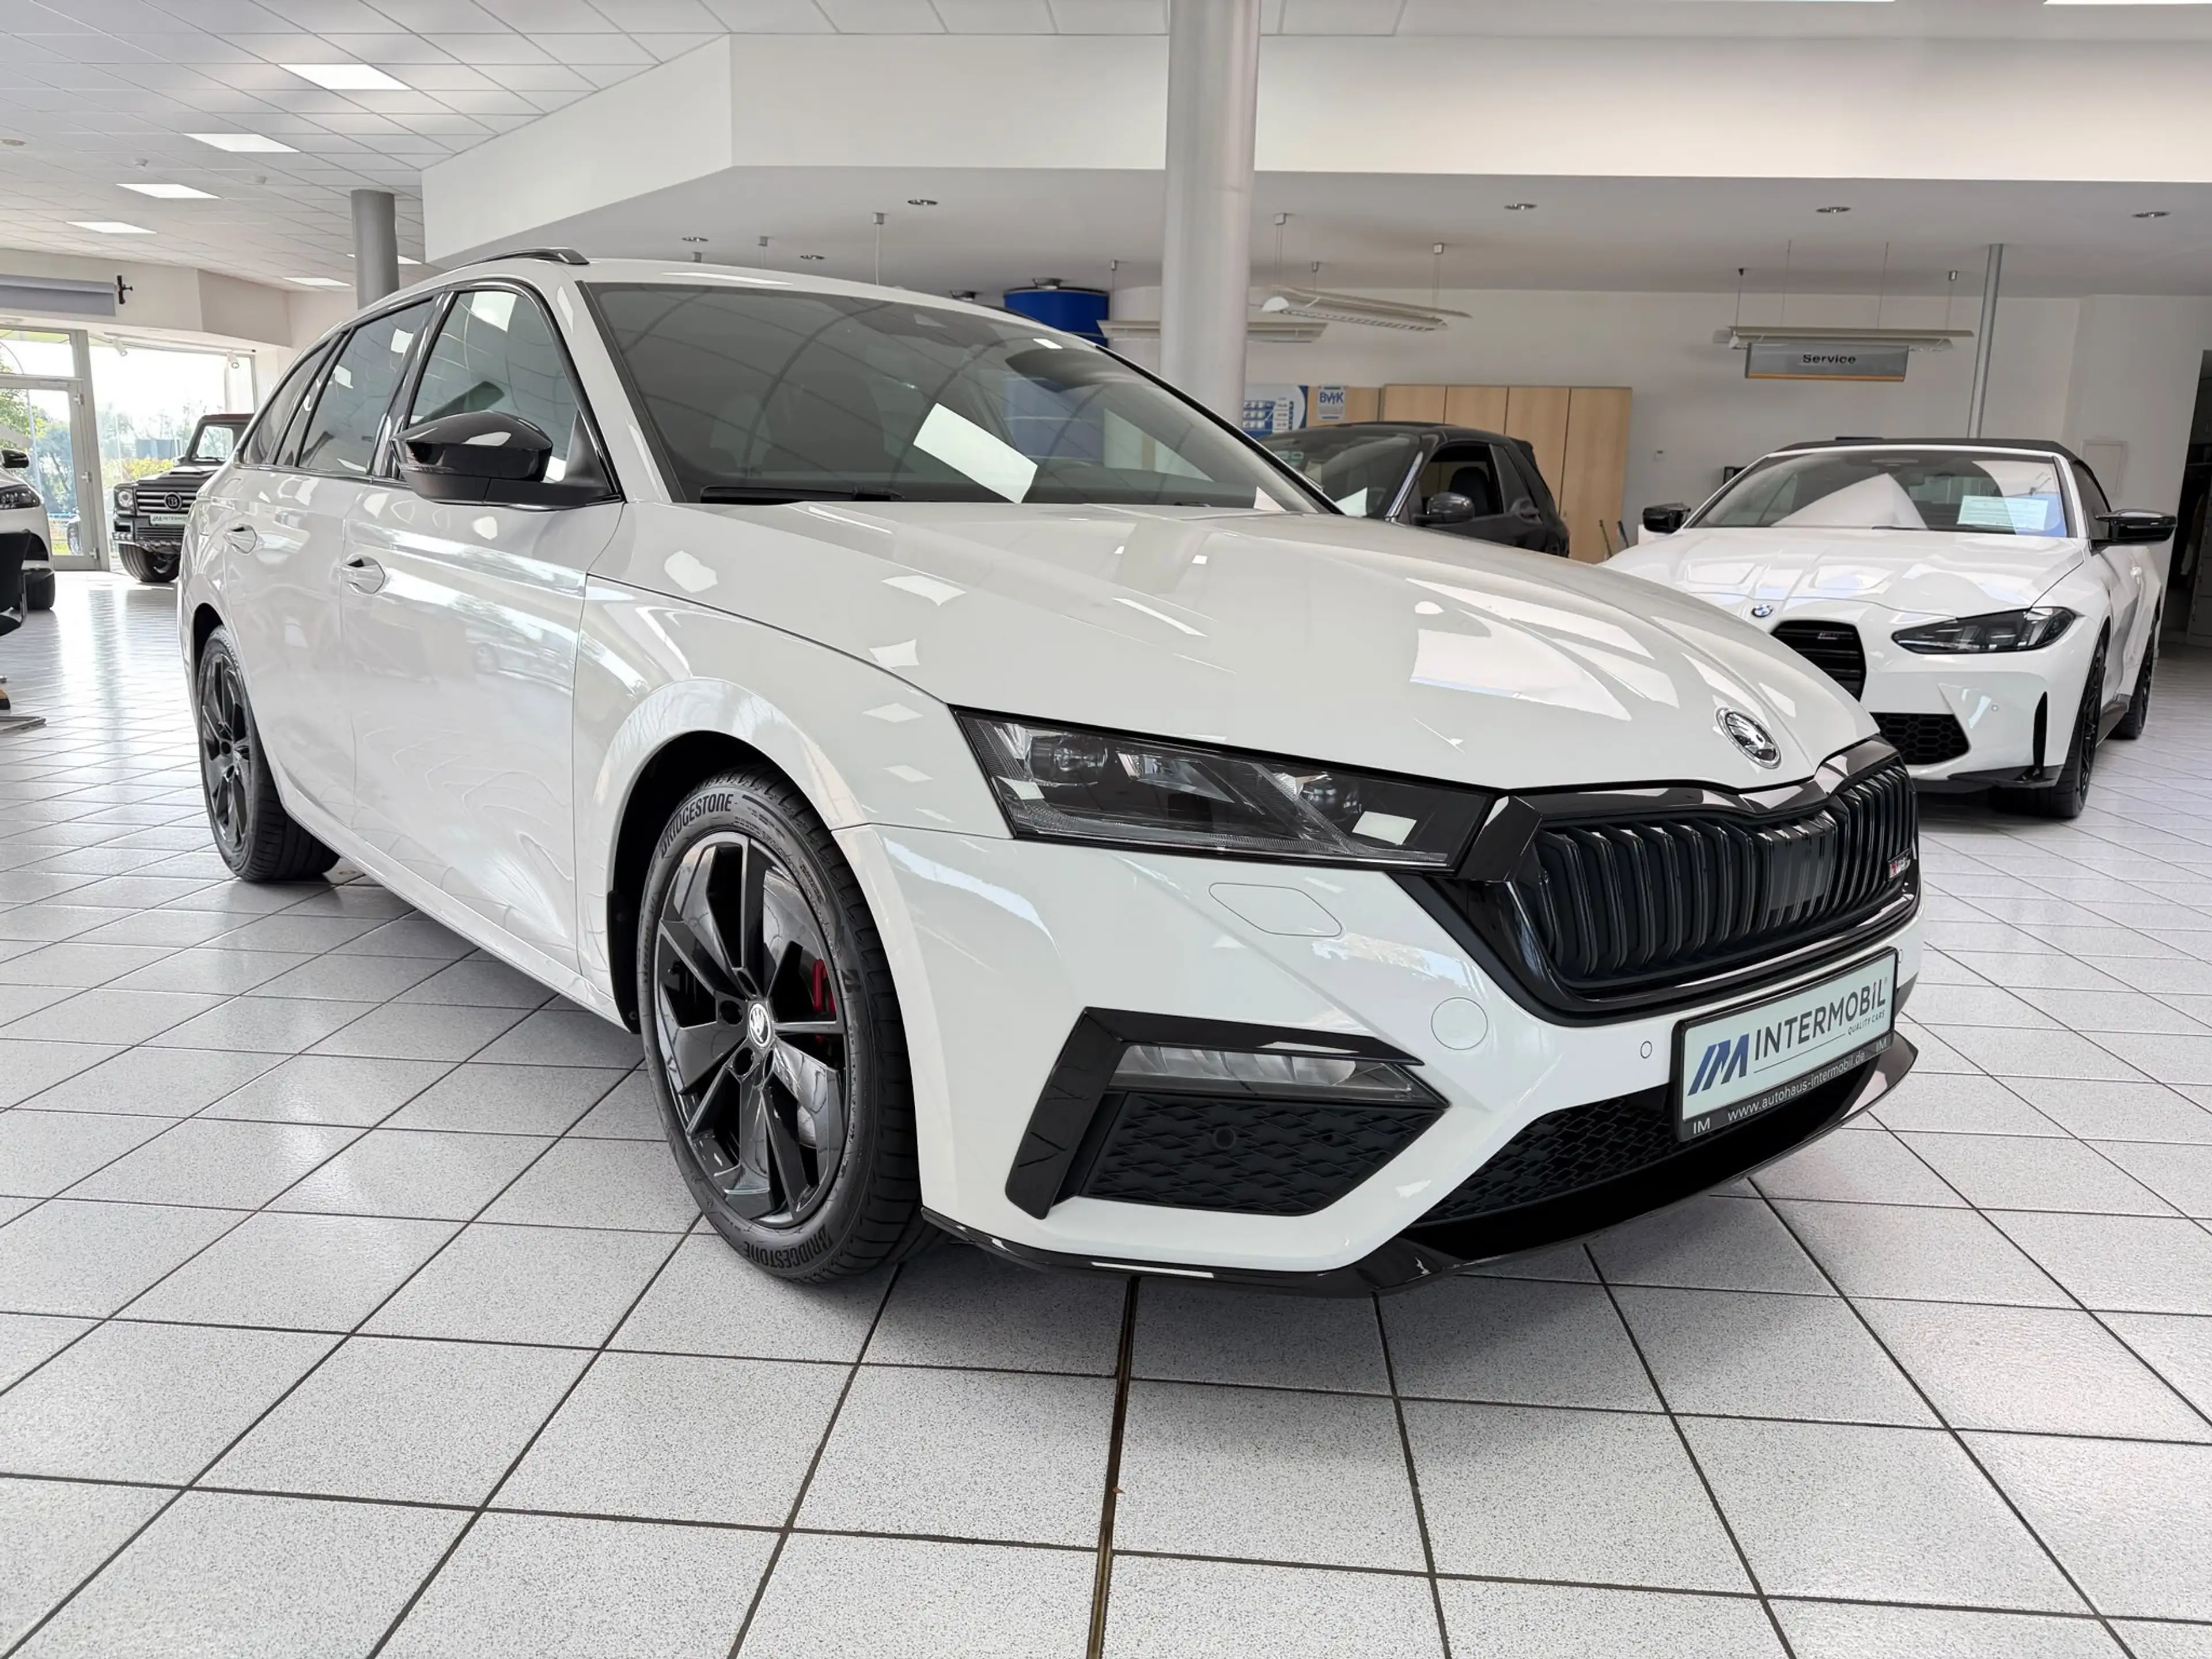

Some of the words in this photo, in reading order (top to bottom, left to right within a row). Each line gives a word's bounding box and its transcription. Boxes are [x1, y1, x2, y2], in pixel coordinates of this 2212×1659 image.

[1802, 354, 1856, 364] Service
[661, 793, 734, 857] BRIDGESTONE
[1848, 1018, 1870, 1035] QUALITY
[1872, 1009, 1885, 1022] CARS
[1693, 1117, 1711, 1134] IM
[1728, 1050, 1865, 1122] www.autohaus-intermobil.de
[1875, 1037, 1888, 1052] IM
[744, 1223, 833, 1268] BRIDGESTONE
